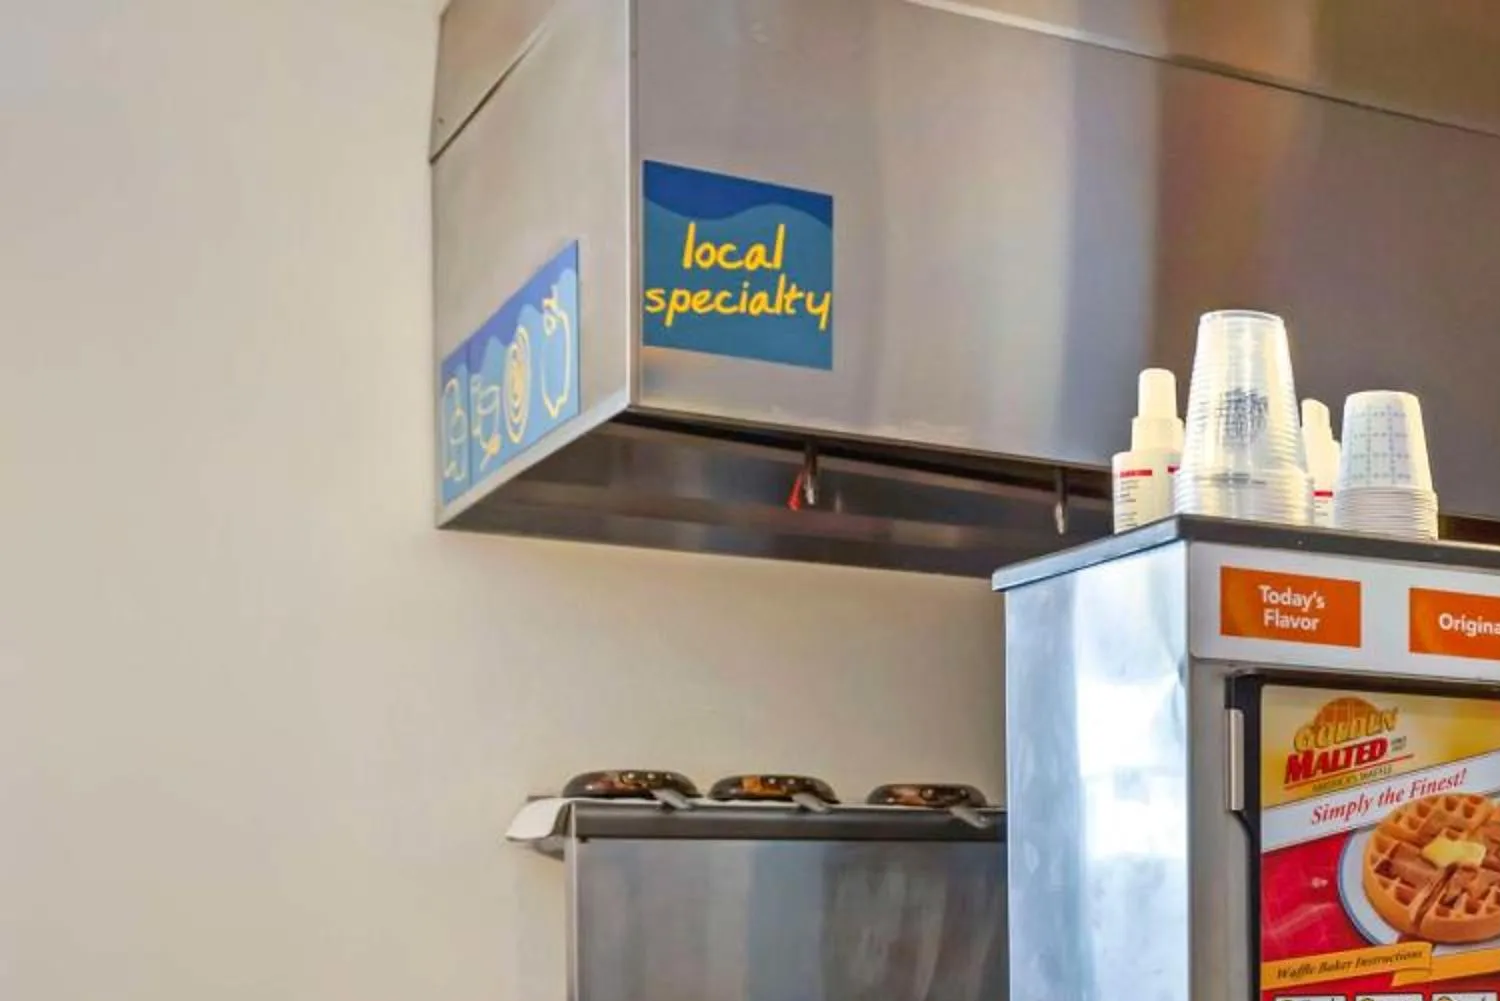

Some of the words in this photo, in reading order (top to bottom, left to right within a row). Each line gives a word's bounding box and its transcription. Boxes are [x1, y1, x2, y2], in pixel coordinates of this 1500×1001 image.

[682, 222, 786, 271] local
[644, 273, 831, 331] specialty
[1258, 585, 1326, 609] Today's
[1263, 608, 1321, 631] Flavor
[1284, 737, 1389, 785] MALTED
[1311, 793, 1374, 825] Simply
[1378, 786, 1405, 808] the
[1409, 768, 1467, 798] Finest!
[1276, 963, 1315, 980] Waffle
[1318, 959, 1353, 974] Baker
[1355, 951, 1423, 969] Instructions
